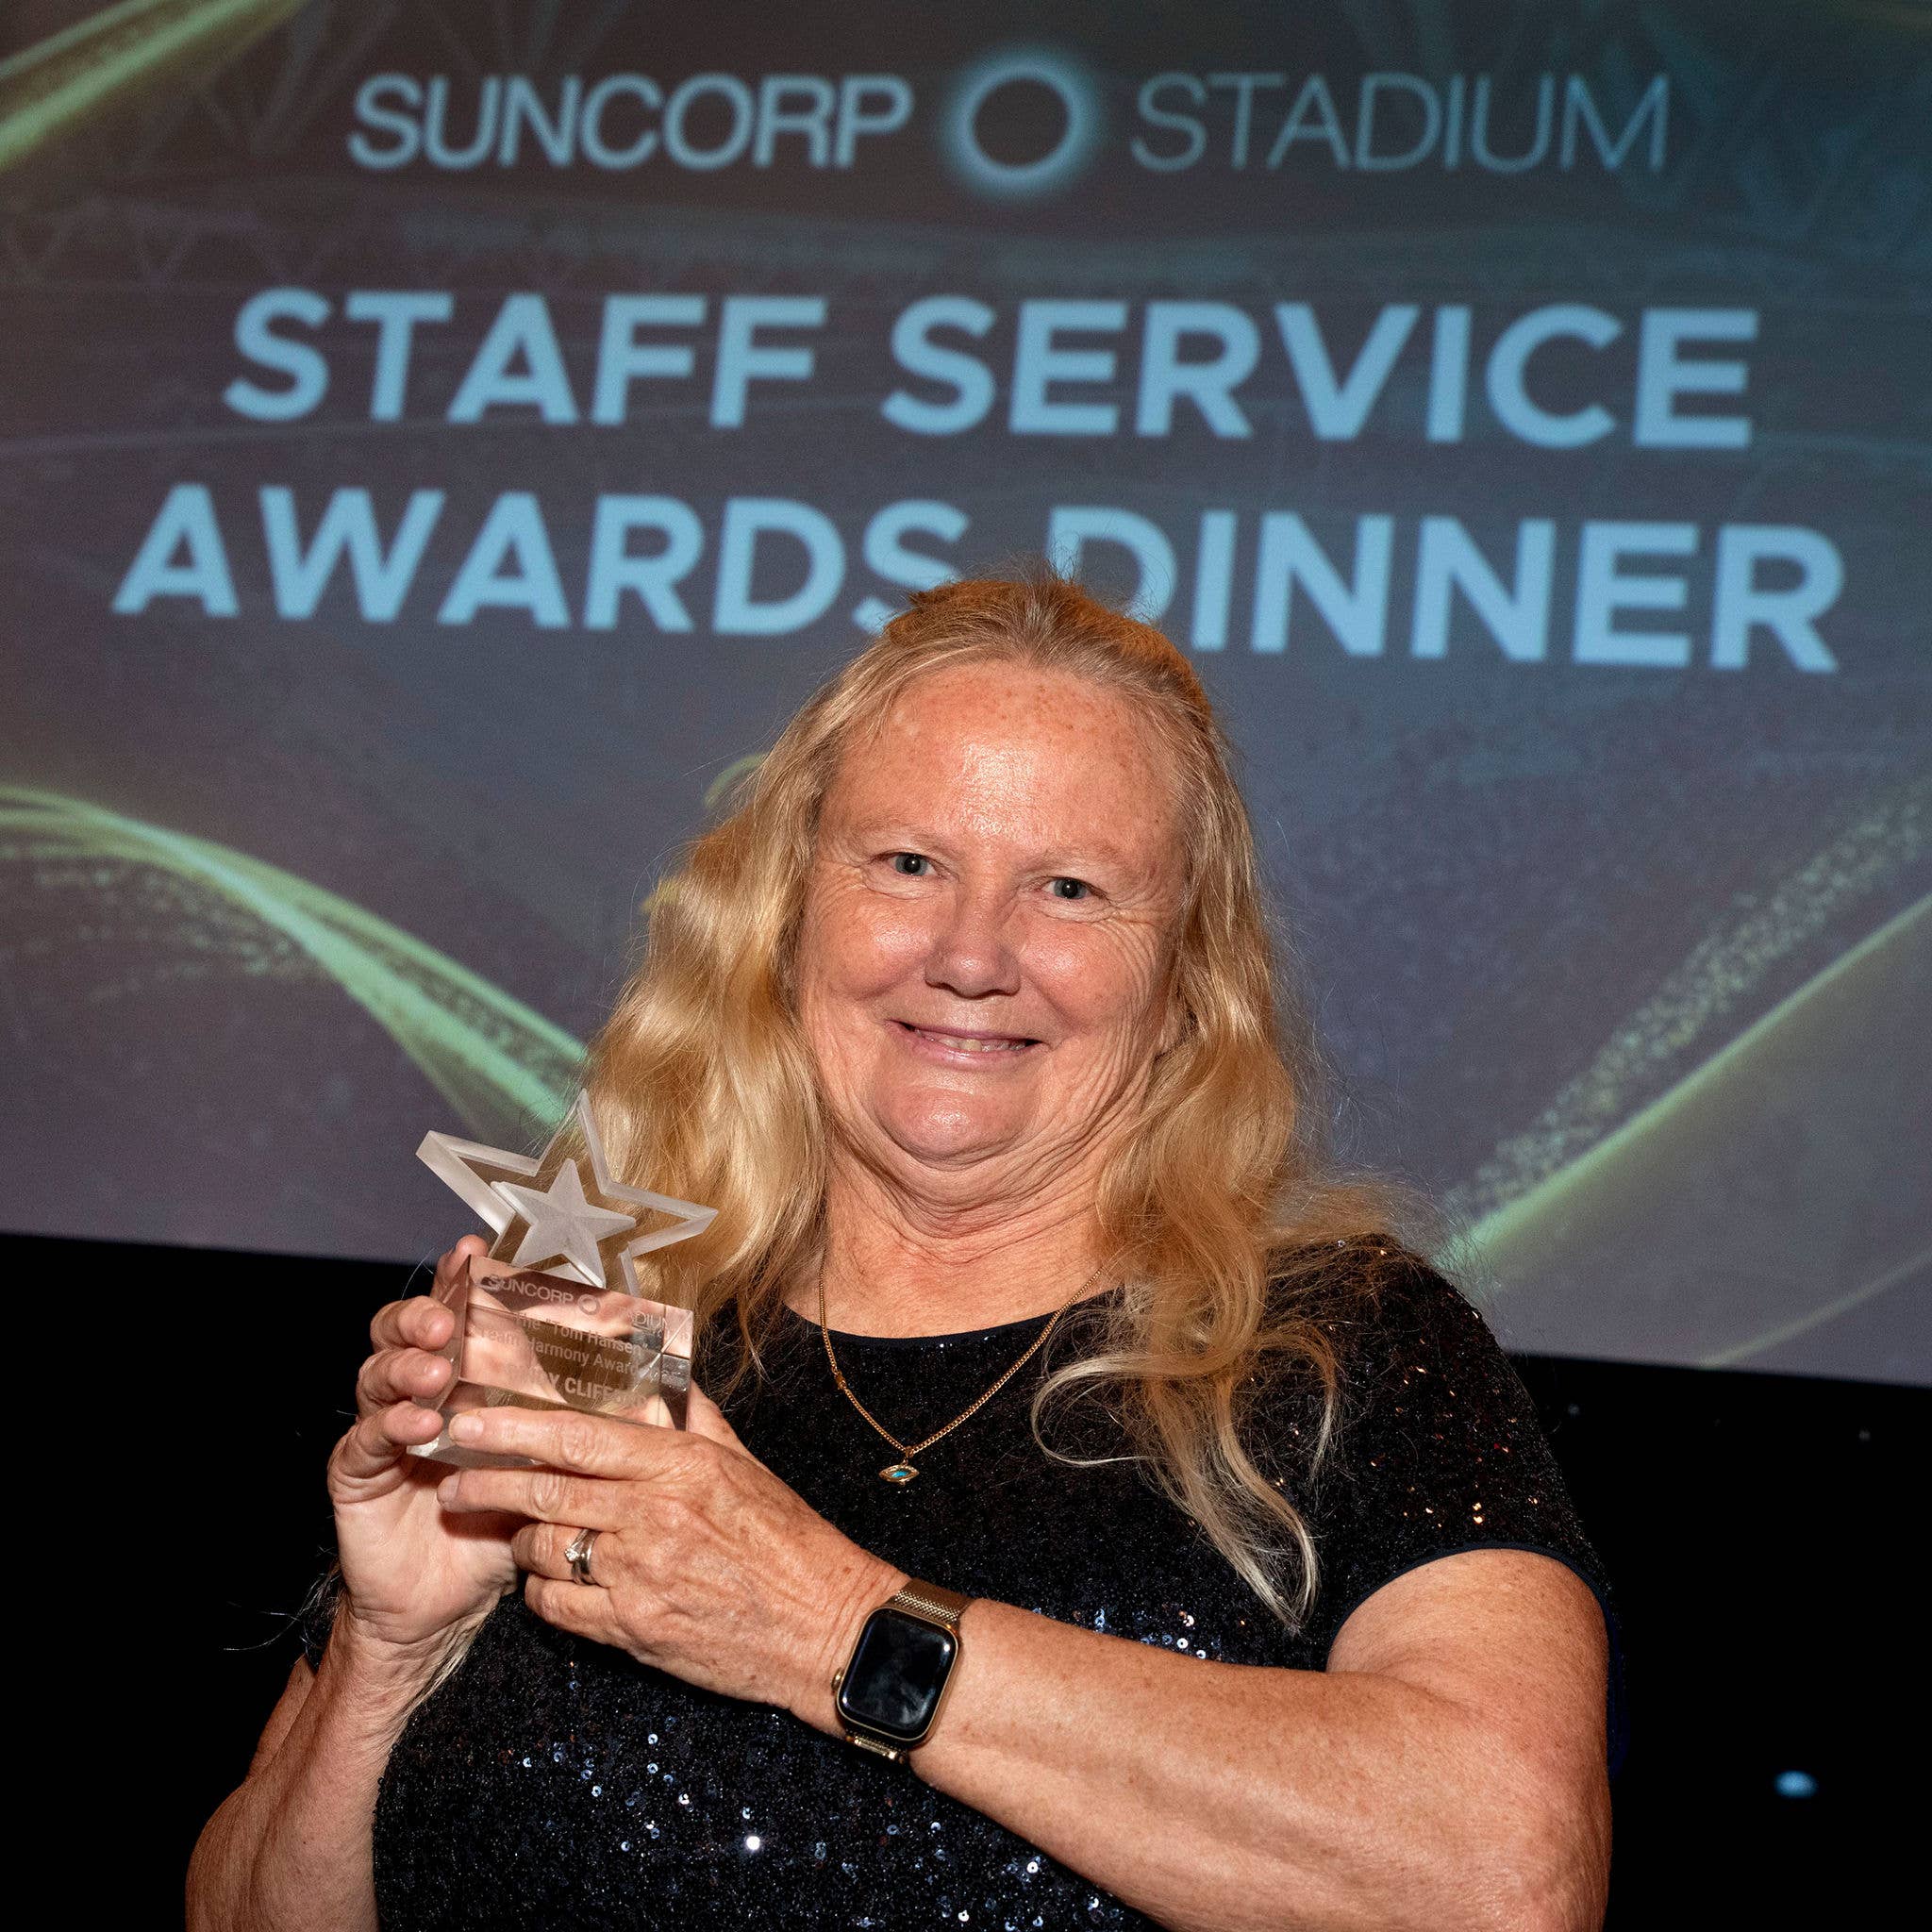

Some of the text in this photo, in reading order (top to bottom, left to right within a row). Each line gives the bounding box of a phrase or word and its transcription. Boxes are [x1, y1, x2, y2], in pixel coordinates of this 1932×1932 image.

[348, 72, 1670, 173] SUNCORP STADIUM
[225, 289, 1758, 451] STAFF SERVICE
[113, 484, 1845, 675] AWARDS DINNER
[488, 1275, 575, 1303] SUNCORP
[528, 1338, 591, 1367] Harmony
[564, 1375, 647, 1406] CLIFF
